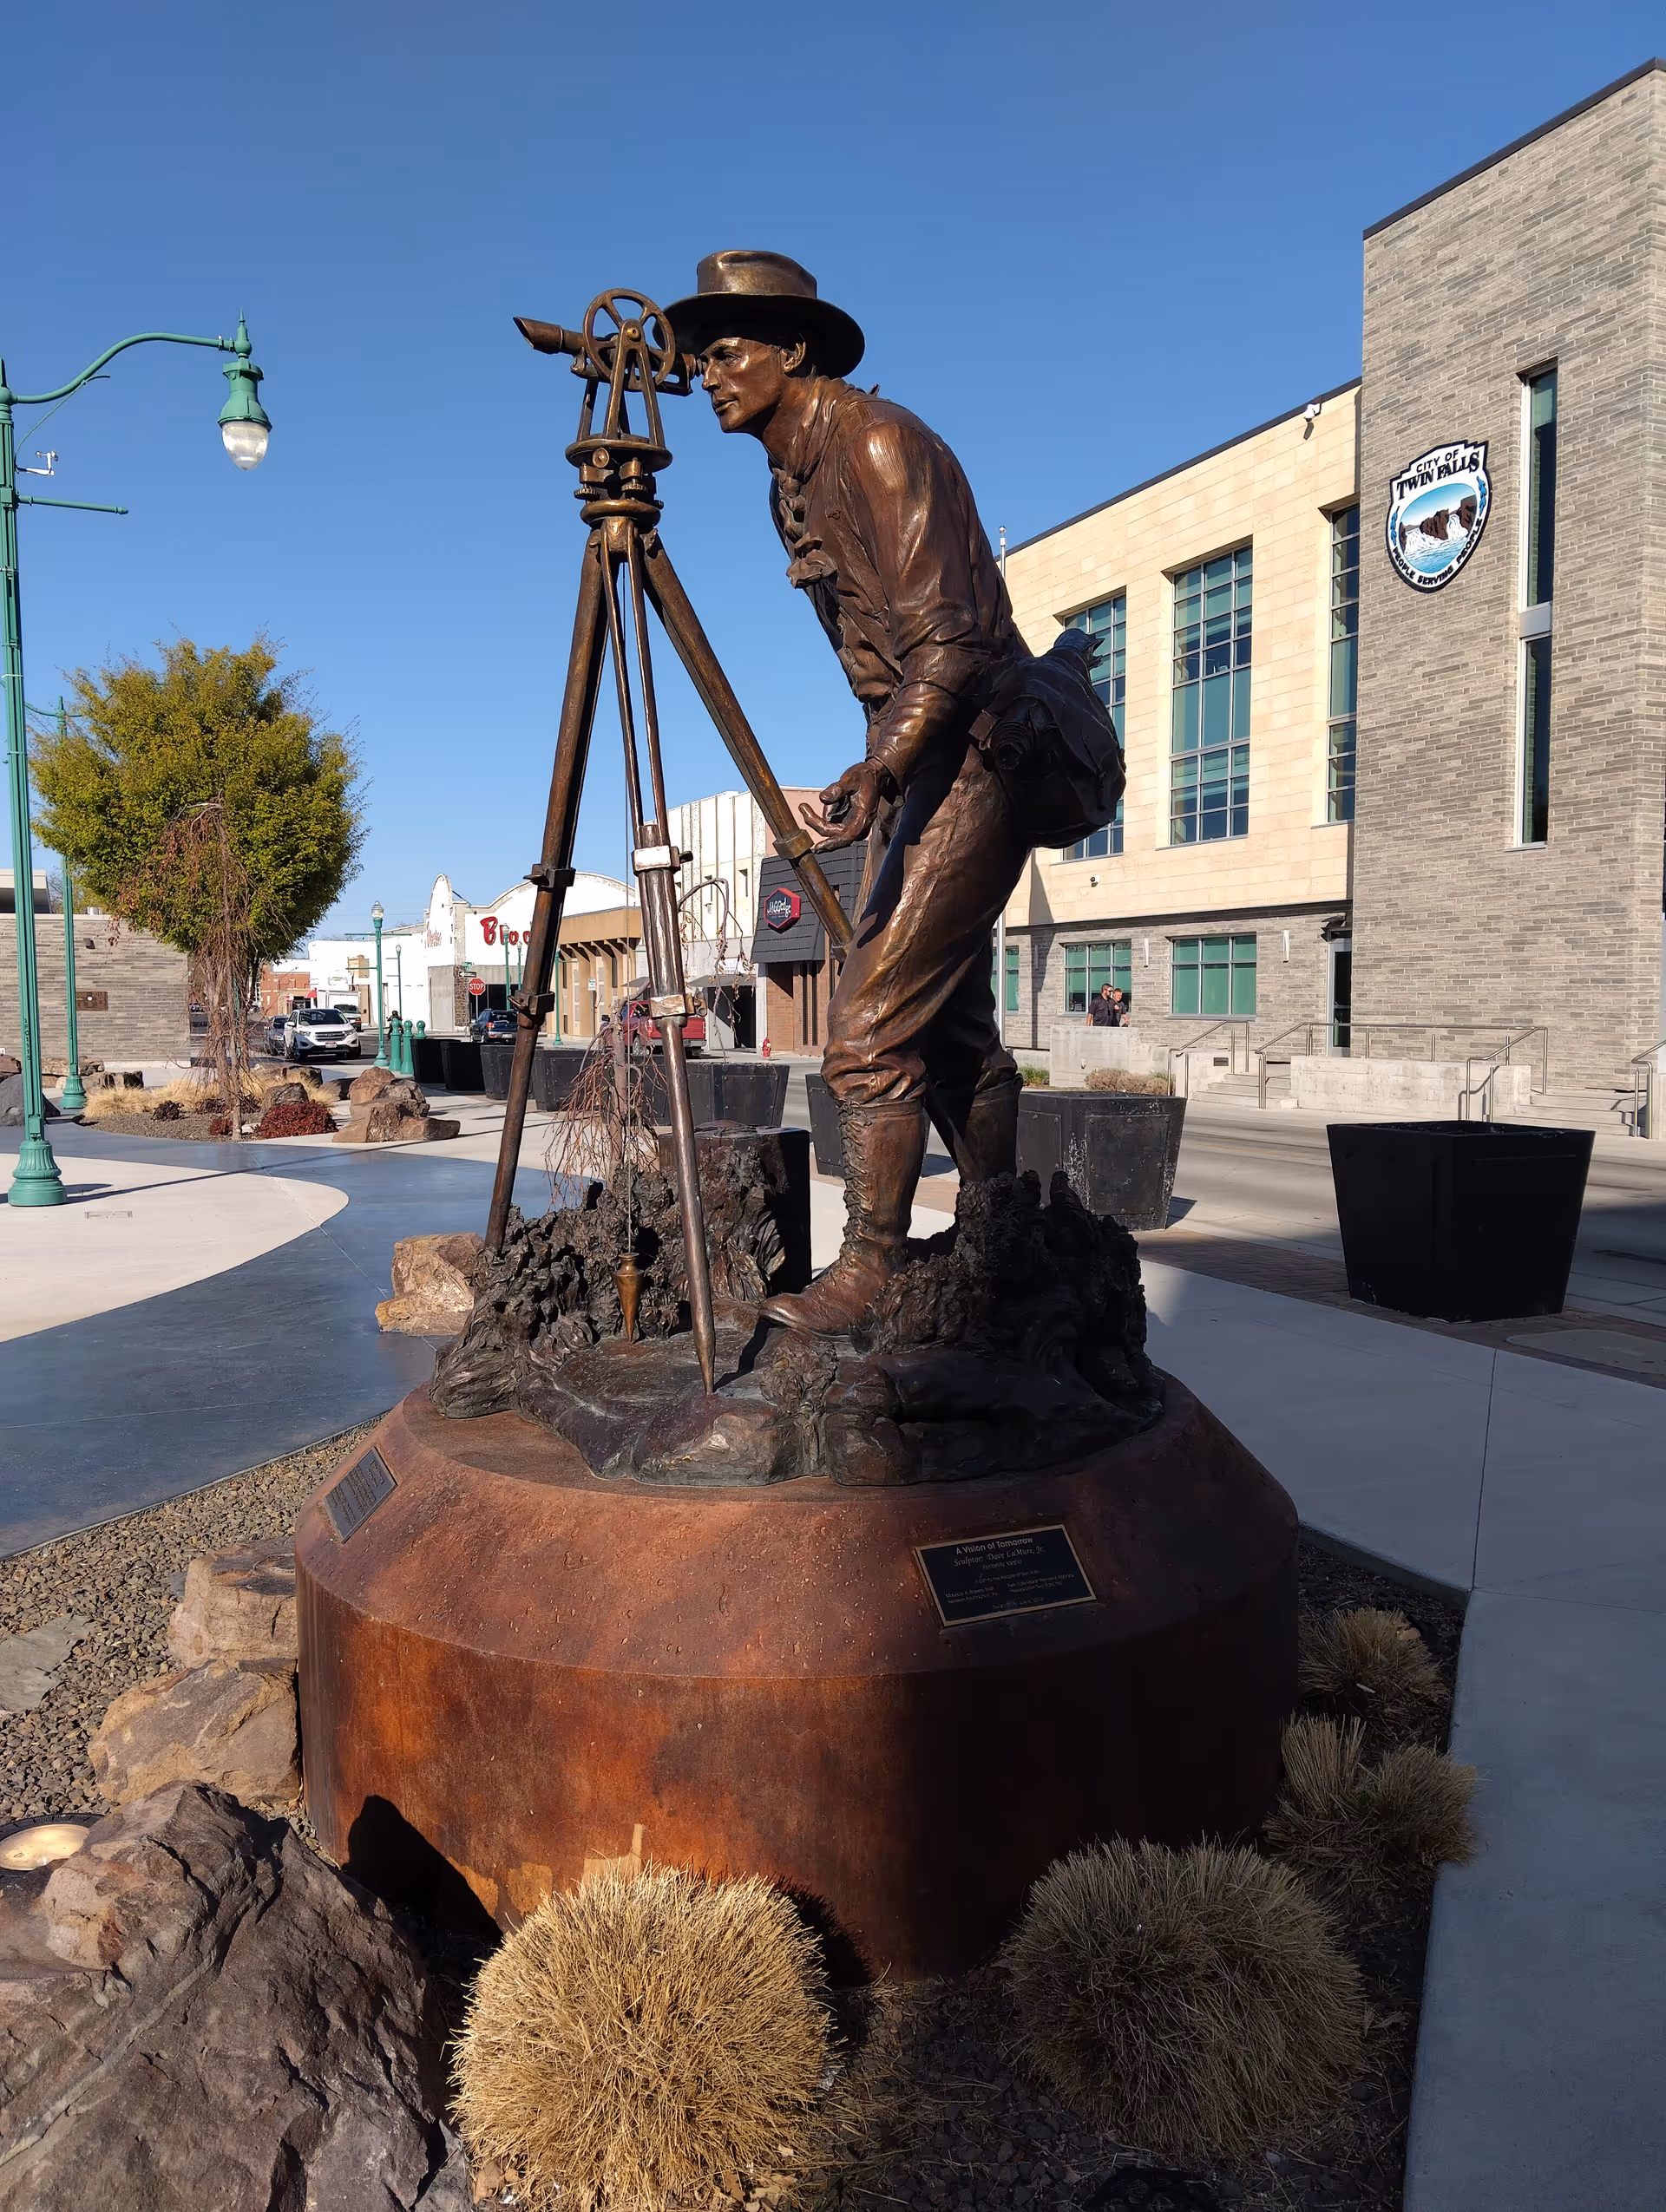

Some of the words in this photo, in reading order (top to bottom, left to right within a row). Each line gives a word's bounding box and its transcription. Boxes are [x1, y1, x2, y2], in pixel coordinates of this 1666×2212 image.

[1416, 456, 1440, 473] CITY
[1445, 448, 1459, 461] OF
[1396, 468, 1434, 501] TWIN
[1437, 450, 1479, 481] FALLS
[1393, 546, 1415, 579] PEOPLE
[1417, 565, 1453, 586] SERVING
[1456, 518, 1483, 564] PEOPLE
[962, 1544, 986, 1554] Vision
[987, 1541, 995, 1550] of
[996, 1537, 1033, 1548] Tomorrow
[987, 1552, 1005, 1561] Dave
[1035, 1546, 1045, 1554] Jr.
